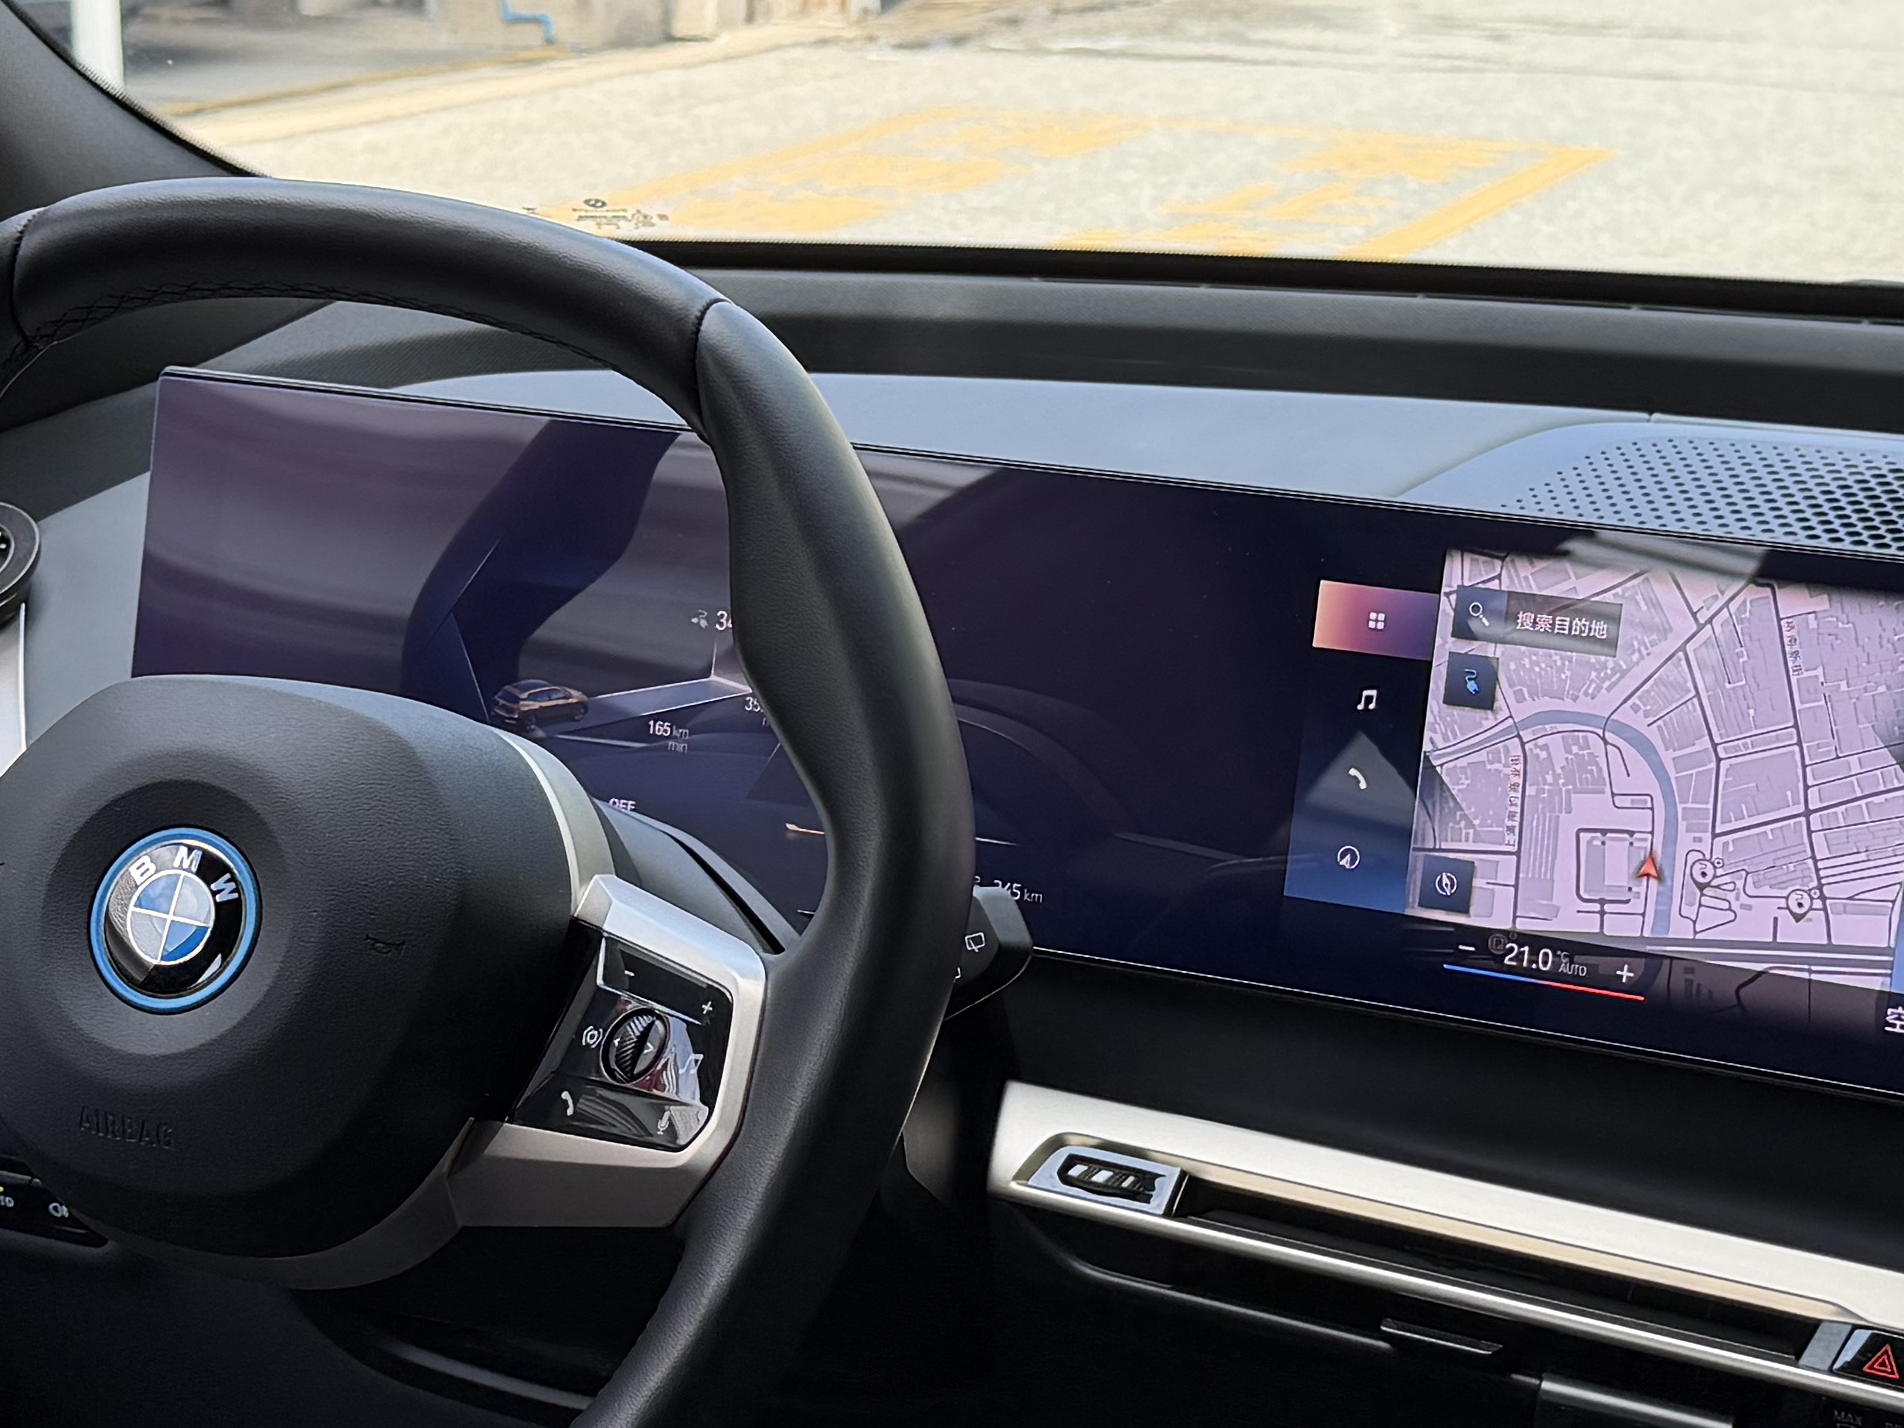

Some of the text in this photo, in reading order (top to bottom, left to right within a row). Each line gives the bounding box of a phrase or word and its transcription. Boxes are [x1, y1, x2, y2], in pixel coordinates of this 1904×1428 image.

[1516, 610, 1609, 639] 搜索目的地
[648, 720, 689, 740] 165 km
[129, 845, 239, 903] BMW
[1024, 888, 1043, 903] km
[1503, 943, 1553, 971] 21.0
[1558, 963, 1587, 977] AUTO
[79, 1105, 174, 1150] AIRBAG
[1833, 1409, 1863, 1426] MAX
